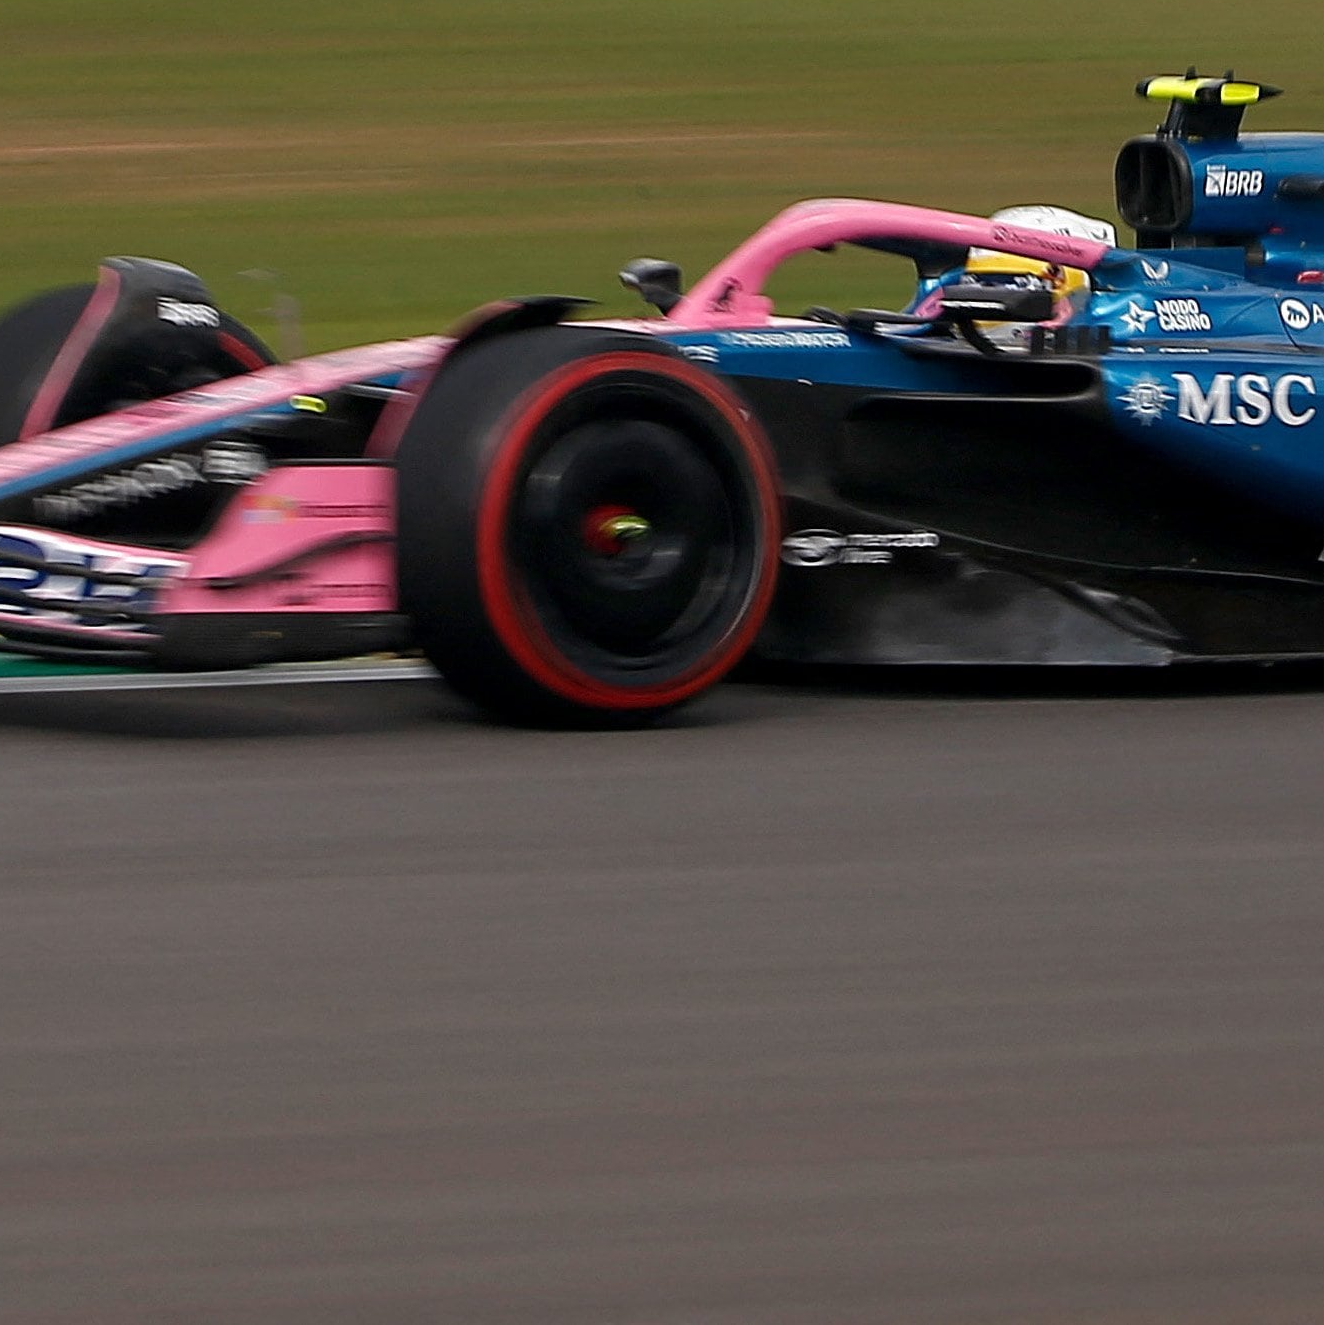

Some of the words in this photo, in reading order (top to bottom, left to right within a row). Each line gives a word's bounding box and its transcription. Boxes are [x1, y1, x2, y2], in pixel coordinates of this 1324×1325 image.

[1225, 170, 1263, 196] BRB
[1159, 312, 1212, 331] CASINO
[1172, 374, 1316, 425] MSC
